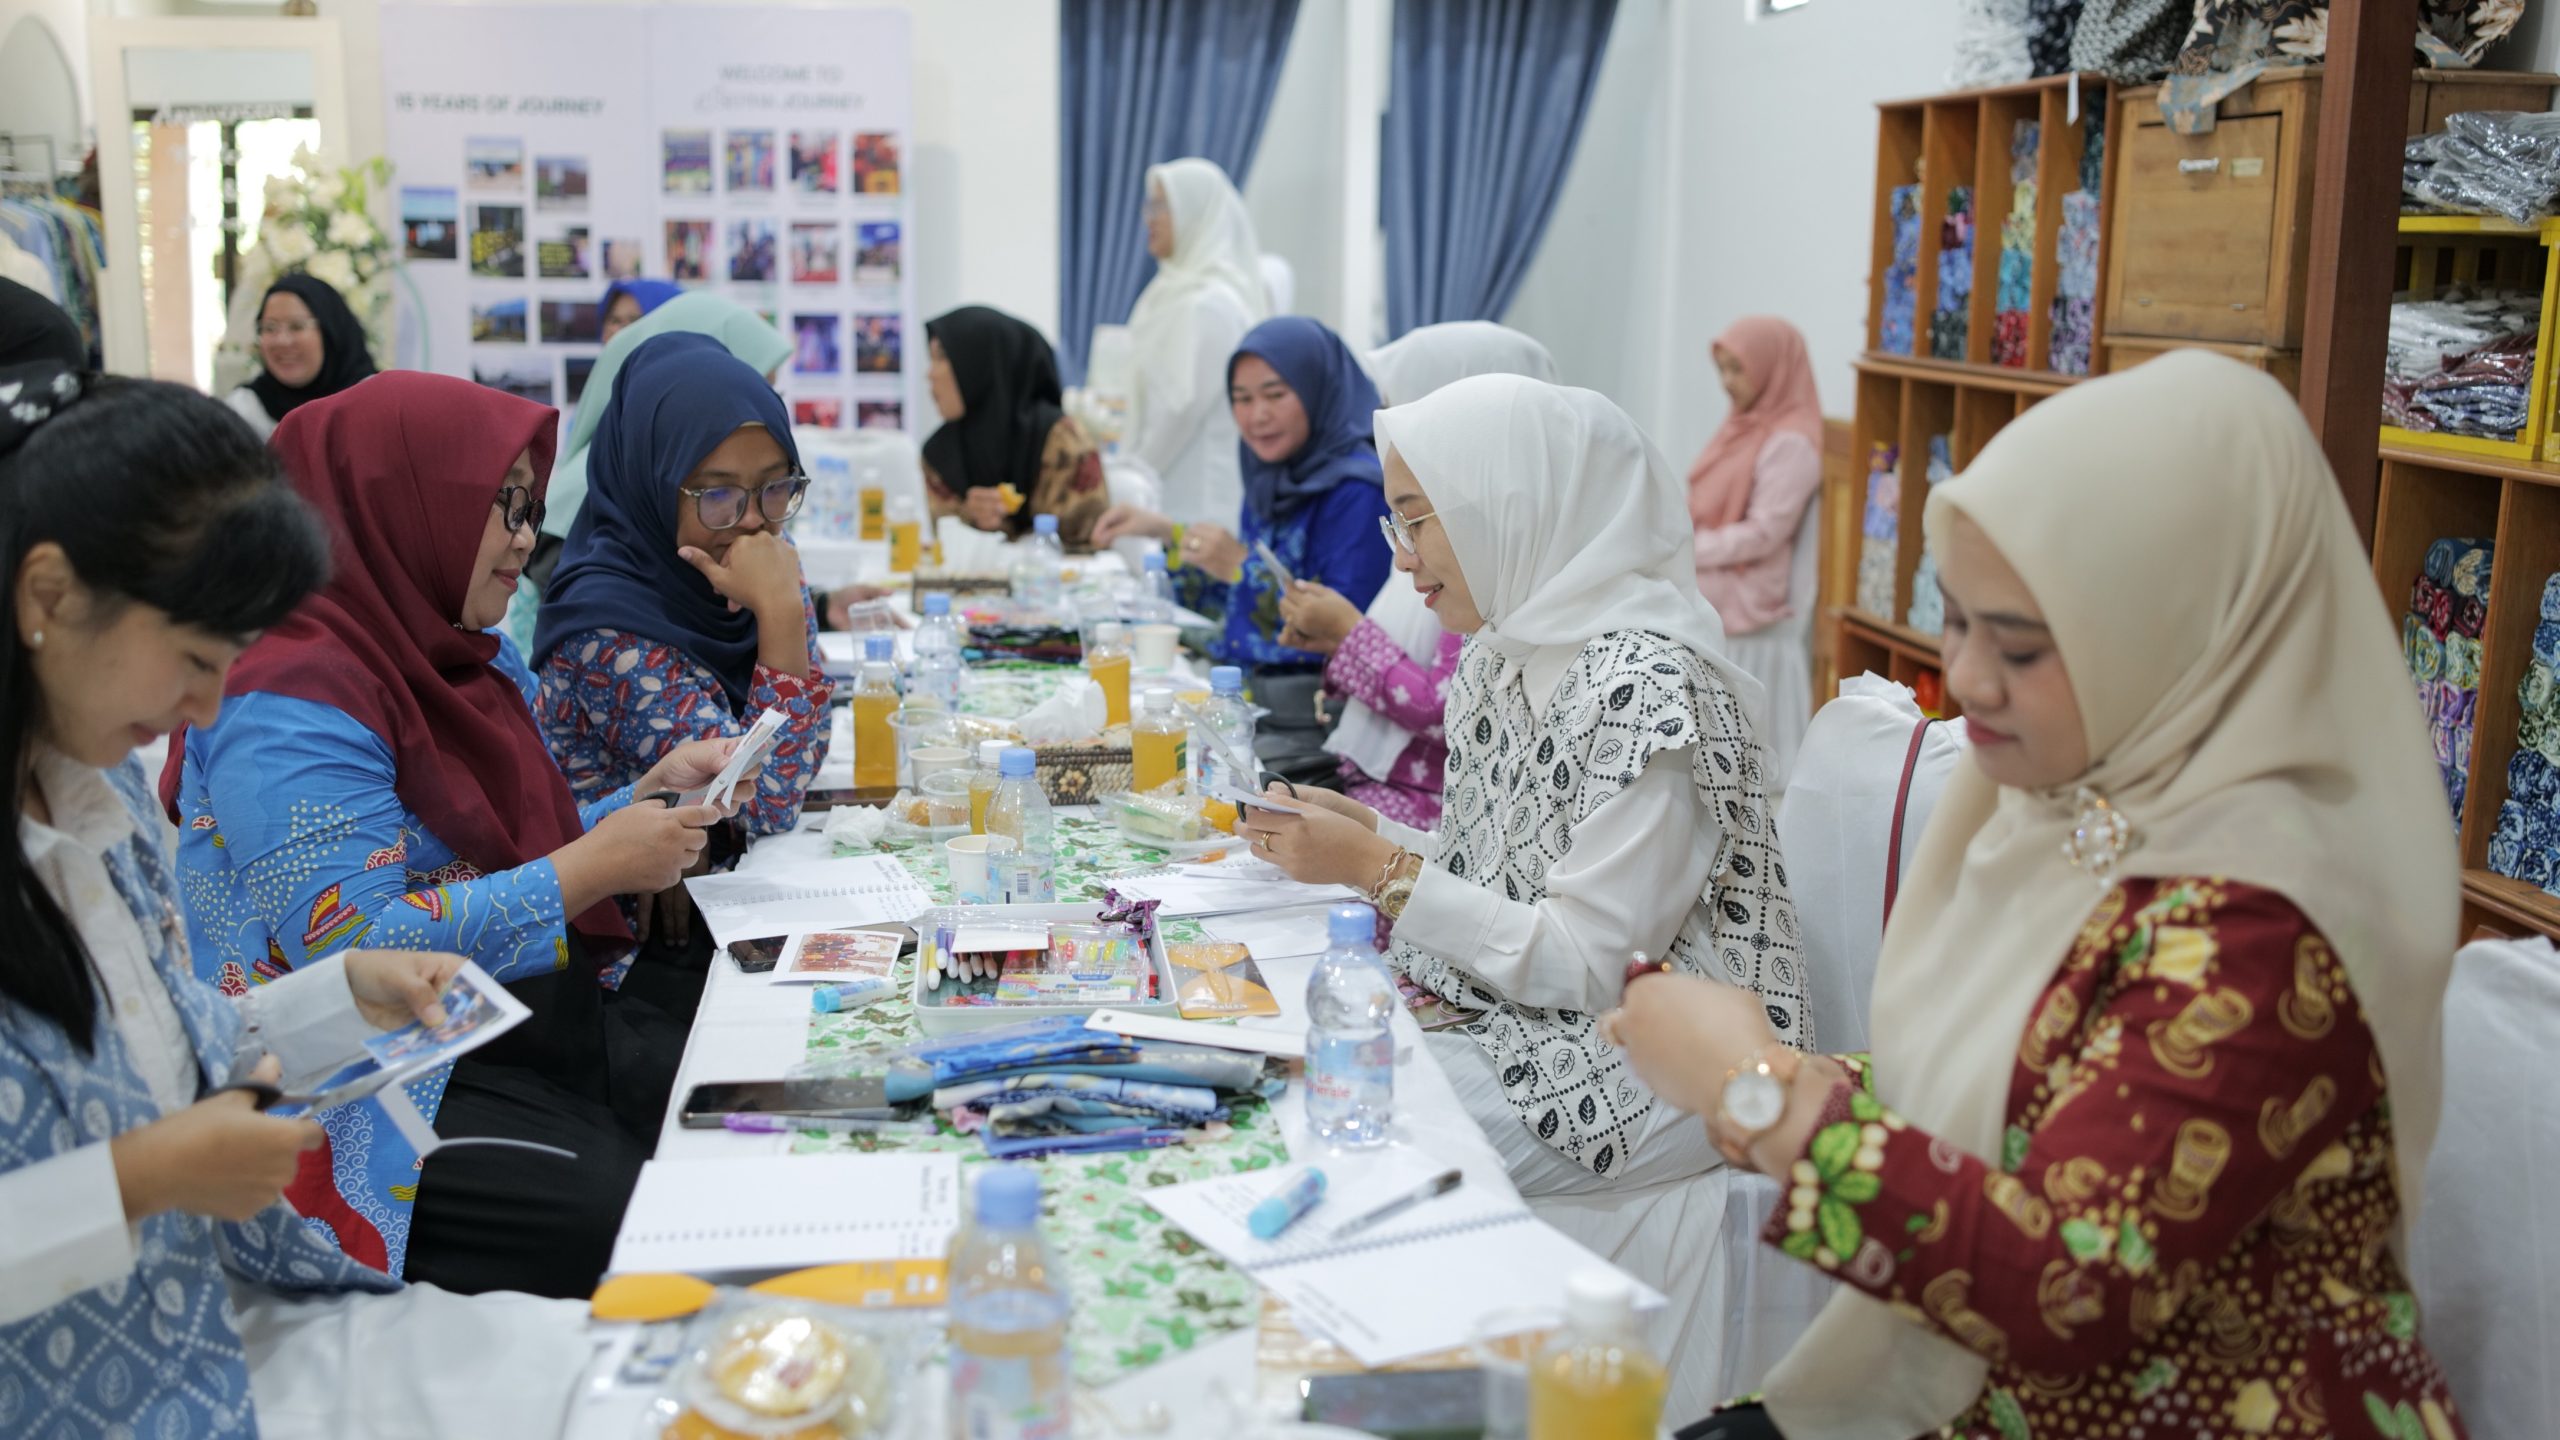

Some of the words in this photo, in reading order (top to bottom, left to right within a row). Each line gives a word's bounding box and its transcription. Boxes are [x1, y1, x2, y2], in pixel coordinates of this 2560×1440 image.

[718, 64, 811, 82] WELCOME
[418, 94, 479, 113] YEARS
[485, 95, 510, 115] OF
[516, 96, 607, 117] JOURNEY
